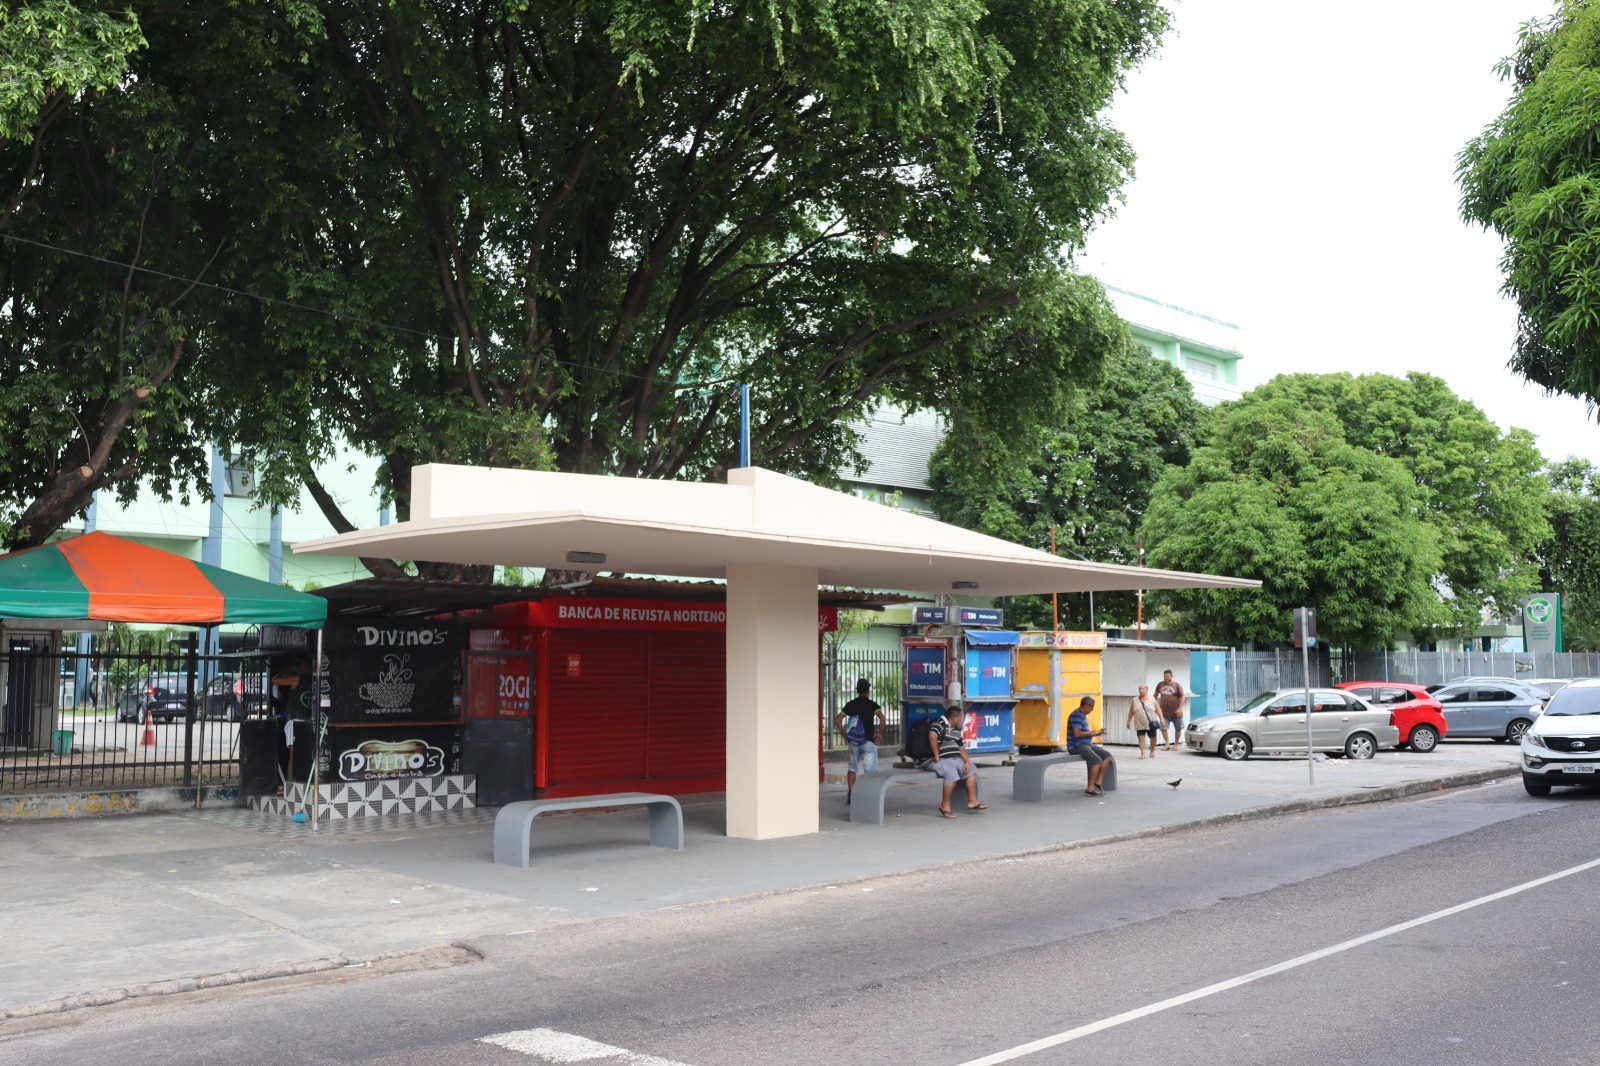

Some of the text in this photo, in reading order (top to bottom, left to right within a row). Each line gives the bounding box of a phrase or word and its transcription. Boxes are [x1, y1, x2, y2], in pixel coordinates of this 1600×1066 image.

[559, 606, 601, 619] BANCA
[604, 608, 620, 620] DE
[623, 609, 671, 621] REVISTA
[923, 663, 941, 674] TIM
[992, 667, 1006, 677] TIM
[985, 716, 999, 726] TIM
